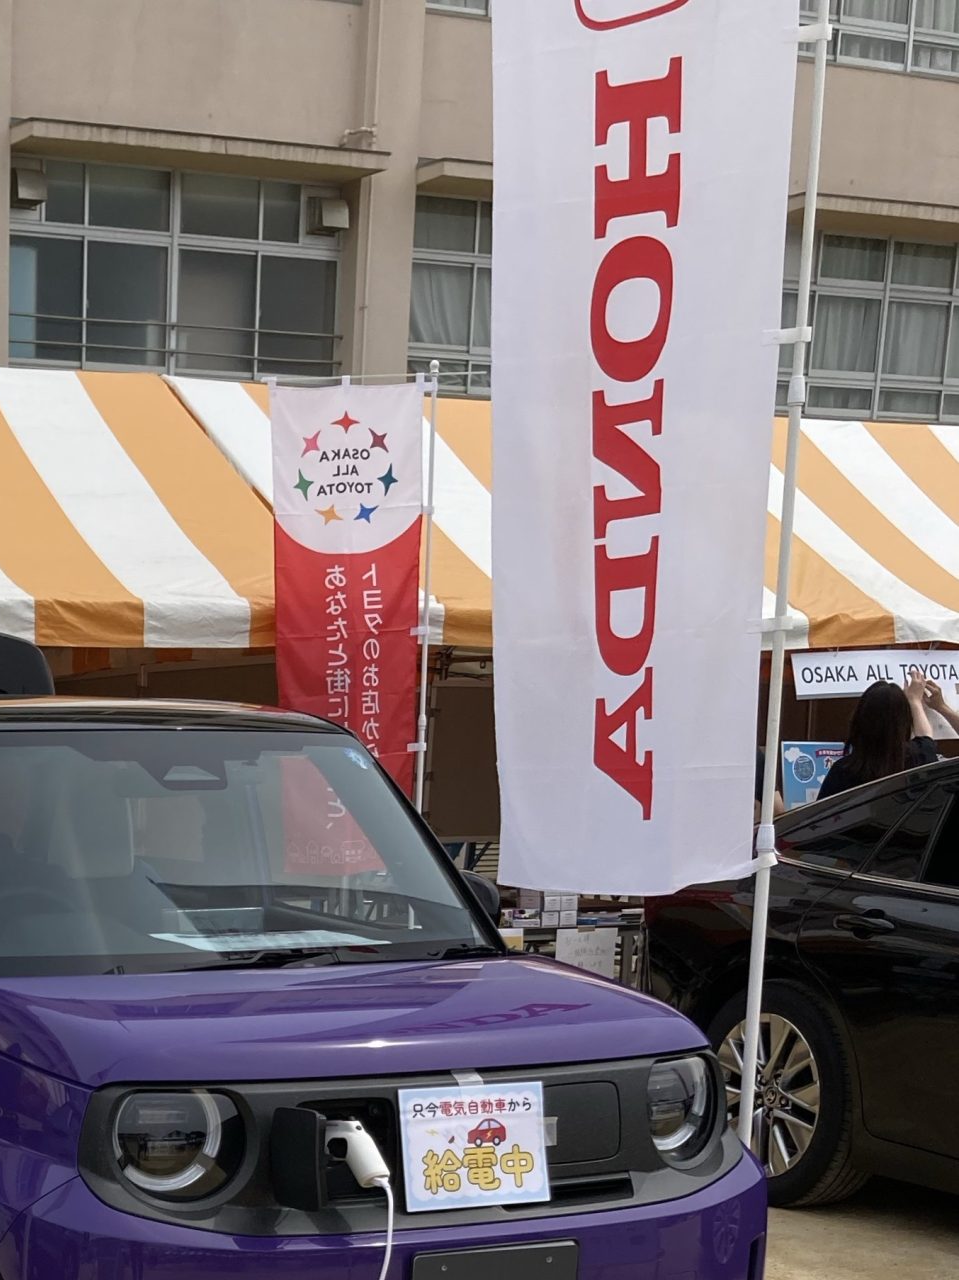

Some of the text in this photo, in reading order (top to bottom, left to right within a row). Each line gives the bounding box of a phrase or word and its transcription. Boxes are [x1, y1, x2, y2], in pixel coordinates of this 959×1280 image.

[801, 665, 859, 684] OSAKA
[866, 664, 893, 681] ALL
[412, 1097, 532, 1119] 只今電気自動車から
[422, 1143, 535, 1195] 給電中
